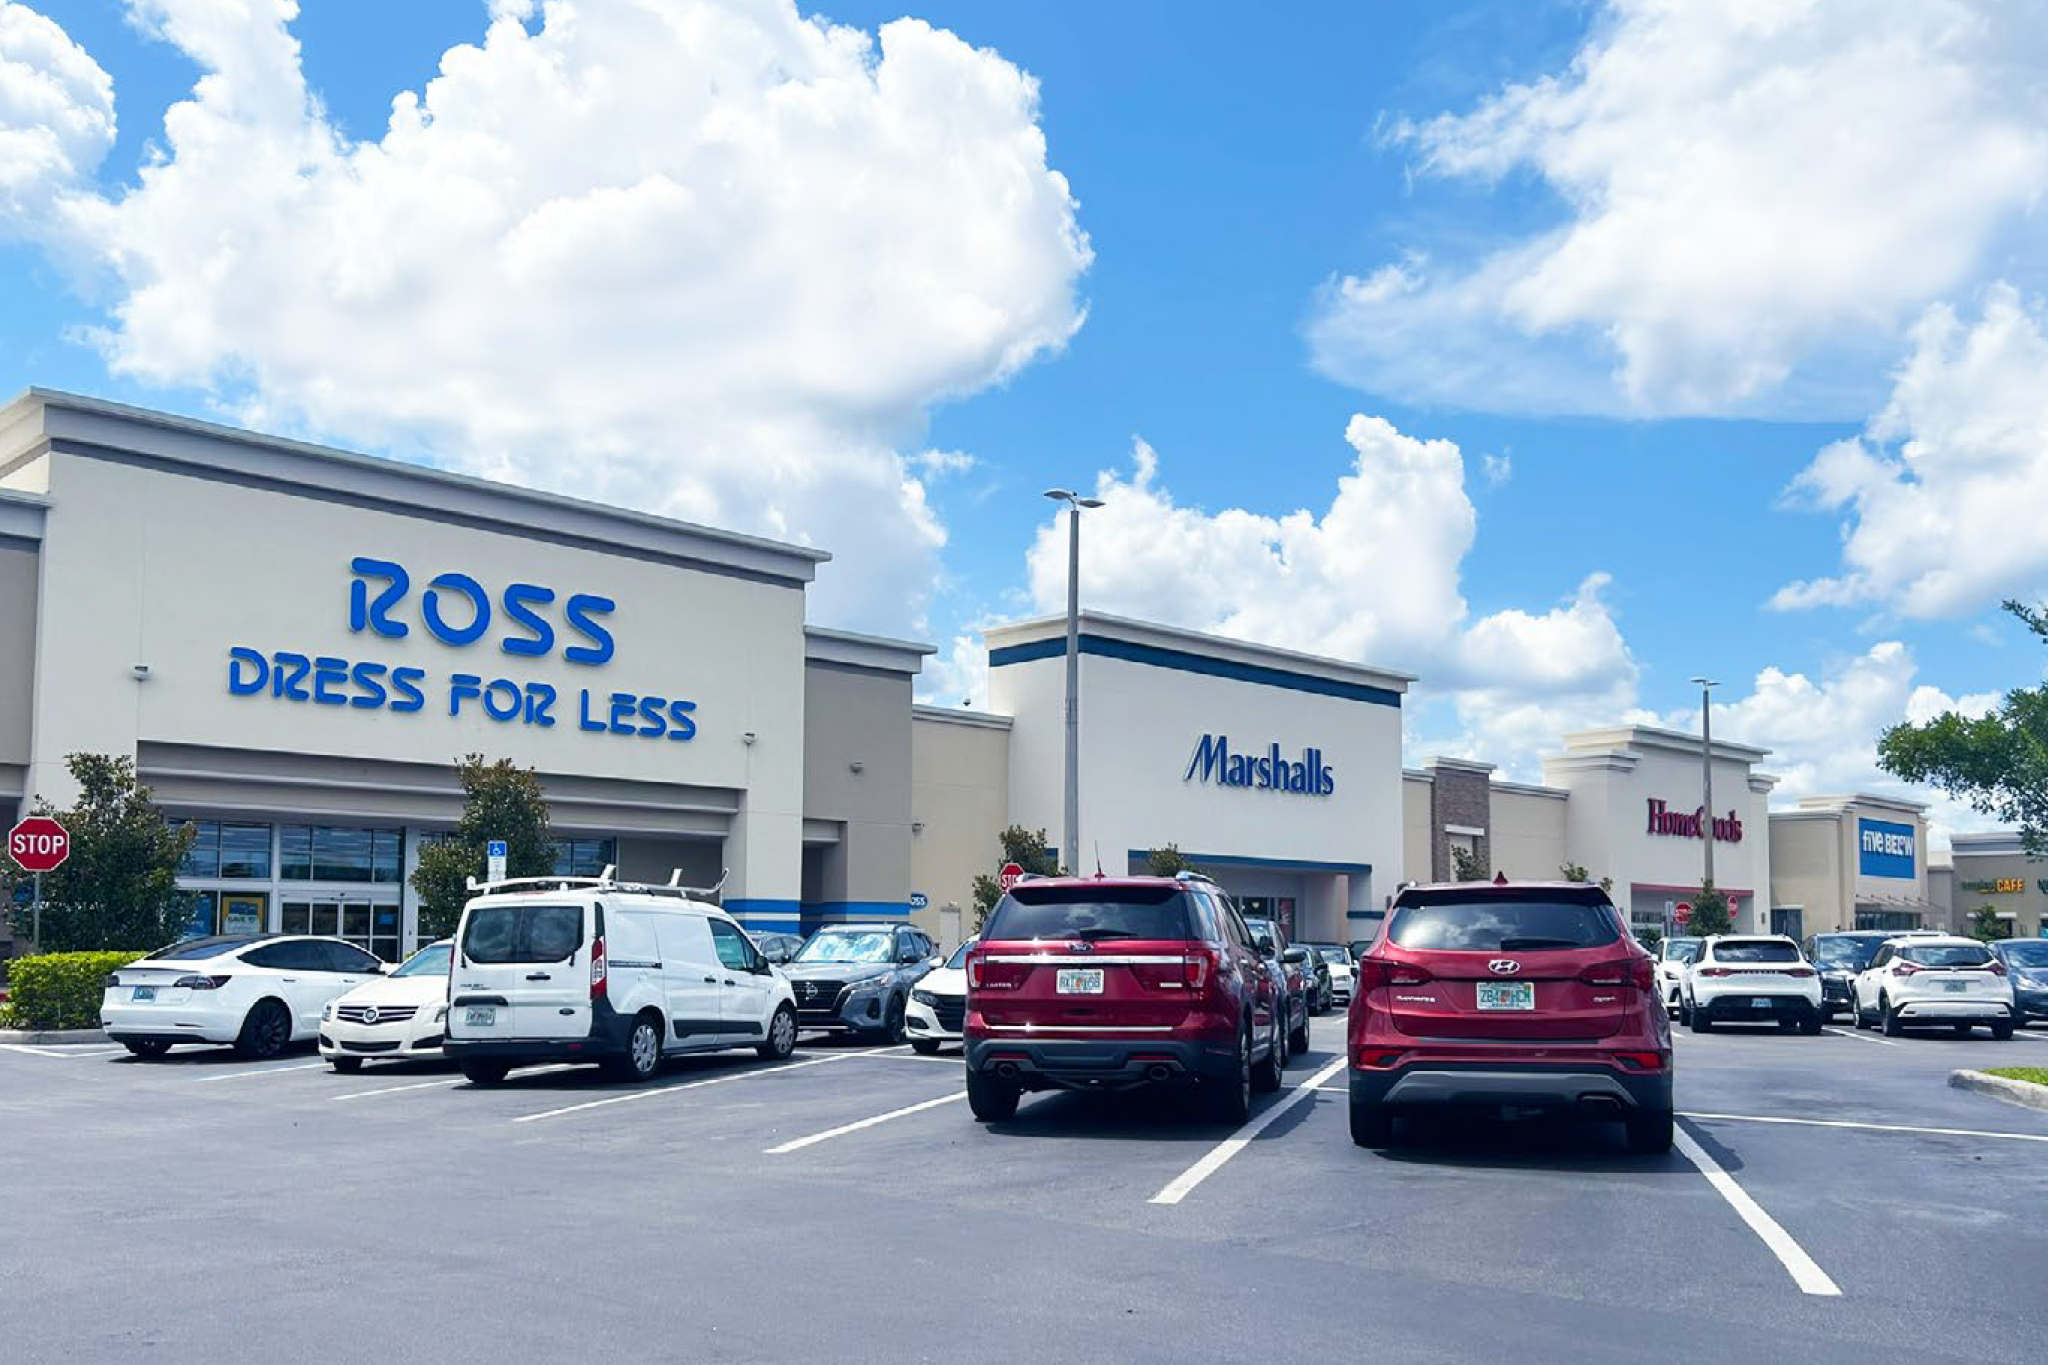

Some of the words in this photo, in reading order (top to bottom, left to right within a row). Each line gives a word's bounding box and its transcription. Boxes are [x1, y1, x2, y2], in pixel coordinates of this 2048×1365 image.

[350, 557, 614, 664] ROSS
[229, 647, 424, 712] DRESS
[450, 674, 556, 729] FOR
[580, 689, 697, 741] LESS
[1185, 733, 1334, 796] Marshalls
[13, 834, 65, 854] STOP
[1647, 798, 1742, 842] HomeGods
[1996, 879, 2024, 893] CAFE
